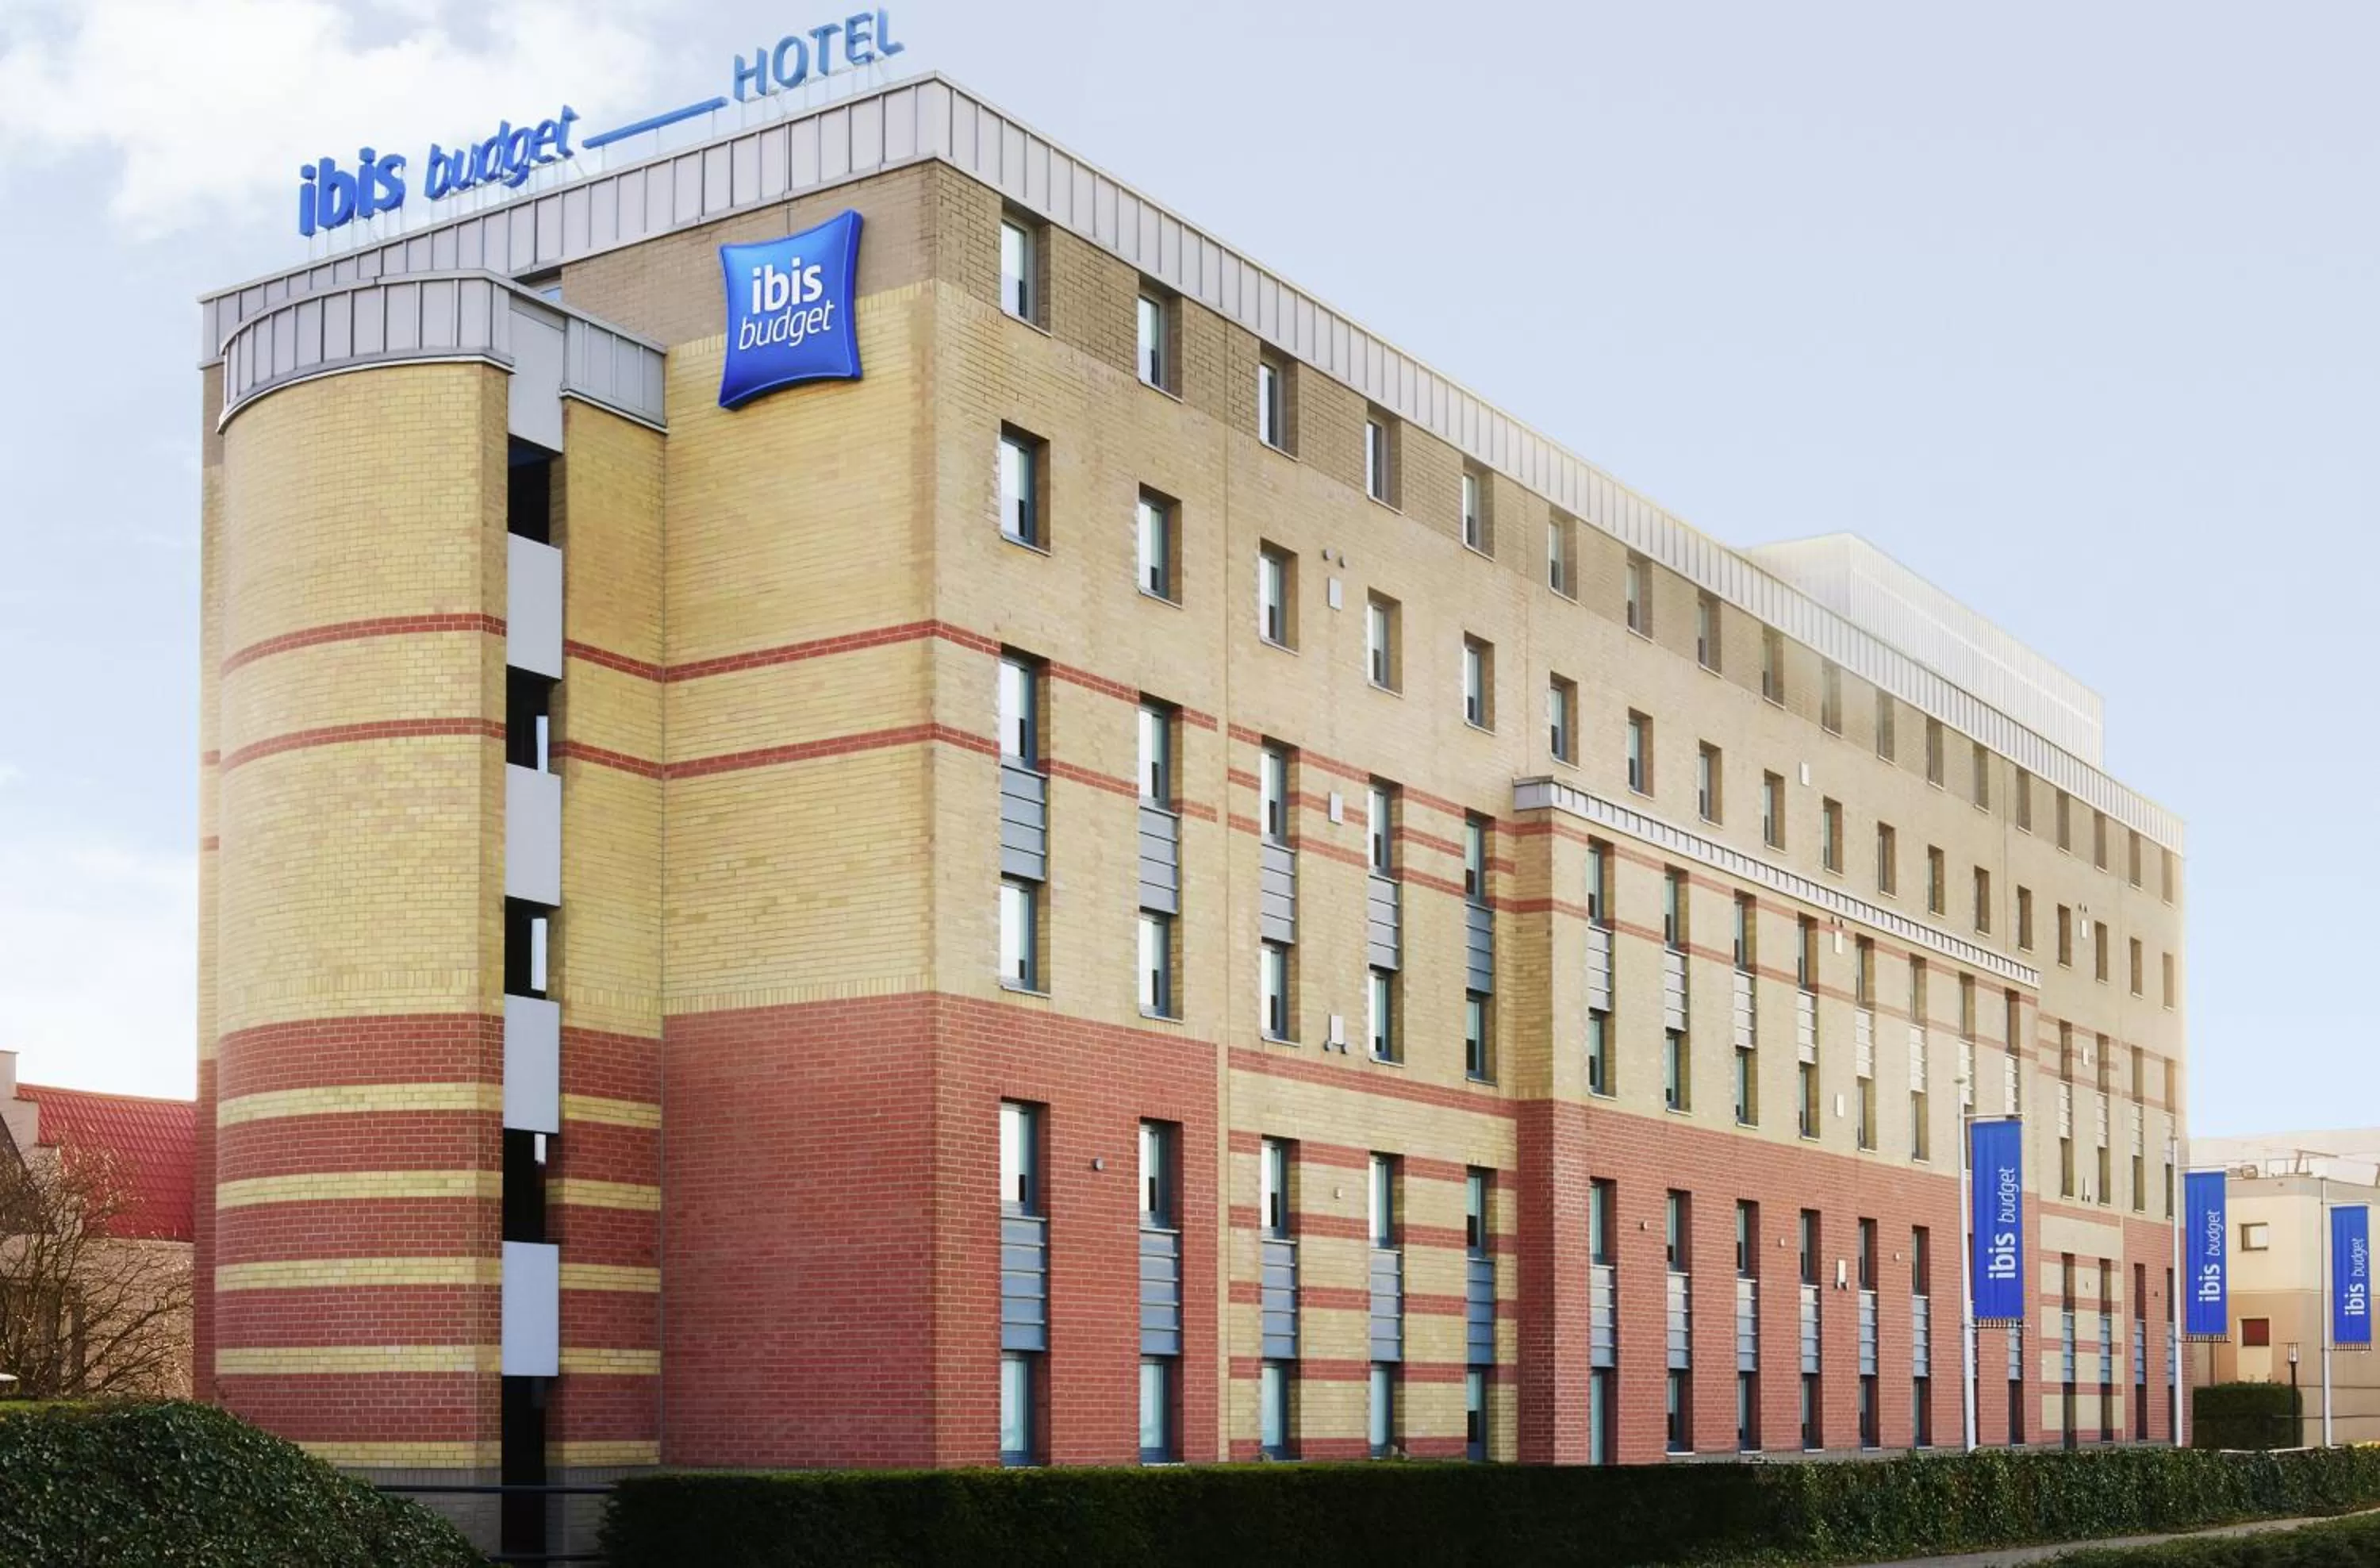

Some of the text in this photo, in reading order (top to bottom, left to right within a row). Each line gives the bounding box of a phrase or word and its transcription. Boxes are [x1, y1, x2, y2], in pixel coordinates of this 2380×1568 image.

[299, 7, 905, 237] ibis budget HOTEL
[739, 297, 835, 351] budget
[751, 257, 823, 315] ibis
[1988, 1166, 2018, 1279] ibis budget
[2198, 1209, 2223, 1303] ibis budget
[2344, 1237, 2367, 1316] ibis budget
